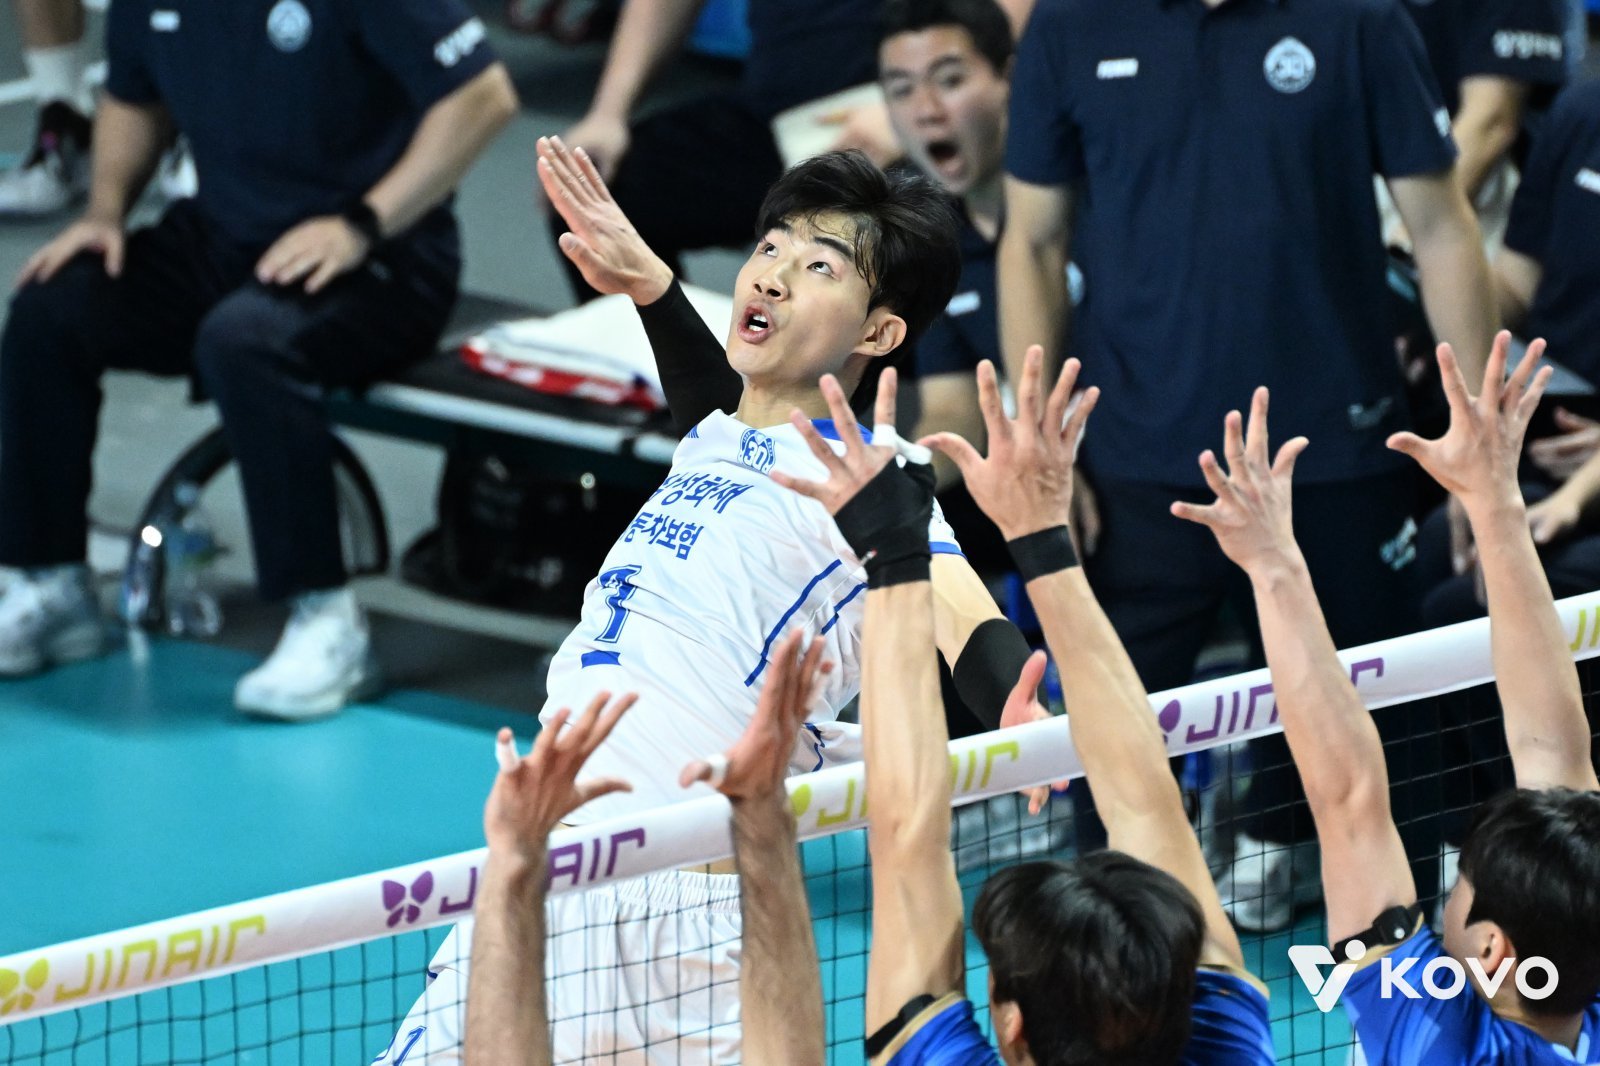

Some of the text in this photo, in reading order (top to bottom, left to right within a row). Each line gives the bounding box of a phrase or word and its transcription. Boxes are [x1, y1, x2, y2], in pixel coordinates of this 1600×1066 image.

[620, 511, 704, 560] 동차보험
[1186, 657, 1384, 744] JINR
[438, 827, 646, 915] JAIR
